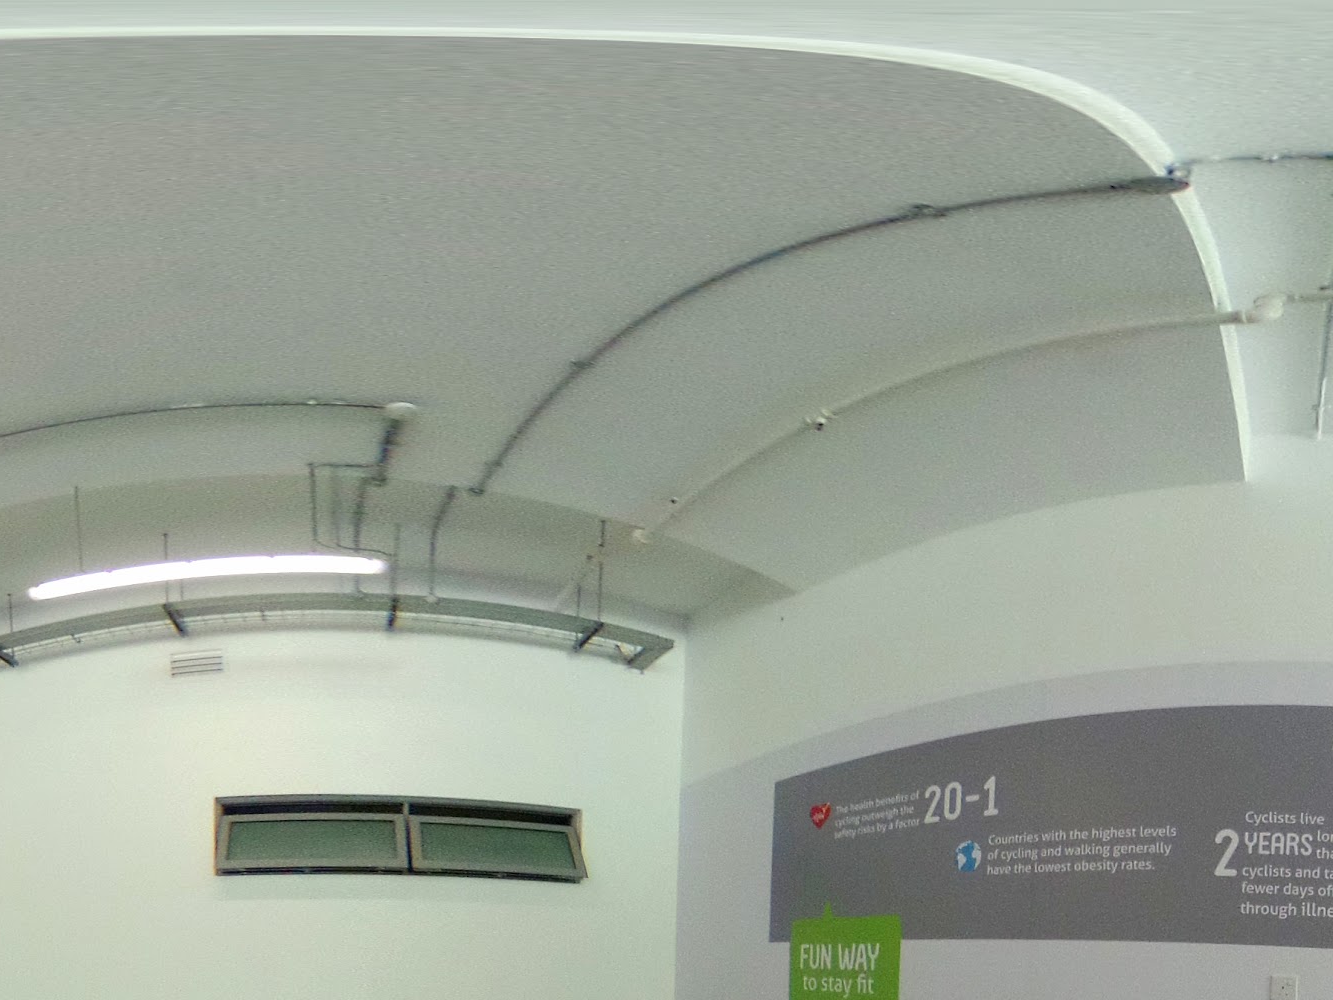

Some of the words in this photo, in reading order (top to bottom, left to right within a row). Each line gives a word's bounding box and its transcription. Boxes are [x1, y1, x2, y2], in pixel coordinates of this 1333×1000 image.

[850, 798, 874, 812] health
[876, 793, 909, 808] benefits
[910, 790, 920, 800] of
[924, 775, 999, 824] 20-1
[861, 808, 898, 822] outweigh
[899, 805, 914, 815] the
[1245, 811, 1296, 826] Cyclists
[1300, 812, 1324, 825] live
[877, 822, 887, 833] by
[888, 822, 893, 830] a
[895, 818, 920, 829] factor
[988, 831, 1039, 846] Countries
[1041, 829, 1067, 842] with
[1069, 828, 1089, 841] the
[1091, 827, 1136, 842] highest
[1140, 825, 1177, 838] levels
[987, 848, 999, 861] of
[1000, 846, 1039, 862] cycling
[1041, 845, 1062, 857] and
[1064, 843, 1110, 858] walking
[1112, 842, 1172, 857] generally
[1214, 829, 1239, 876] 2
[1244, 831, 1313, 856] YEARS
[986, 864, 1012, 876] have
[1014, 862, 1032, 874] the
[1034, 861, 1072, 873] lowest
[1074, 859, 1118, 874] obesity
[1121, 859, 1155, 871] rates.
[1242, 865, 1291, 879] cyclists
[1295, 867, 1320, 879] and
[1241, 881, 1280, 894] fewer
[1283, 883, 1314, 898] days
[1240, 901, 1296, 919] through
[800, 943, 832, 970] FUN
[838, 942, 880, 971] WAY
[803, 975, 817, 991] to
[821, 976, 852, 999] stay
[857, 973, 875, 994] fit
